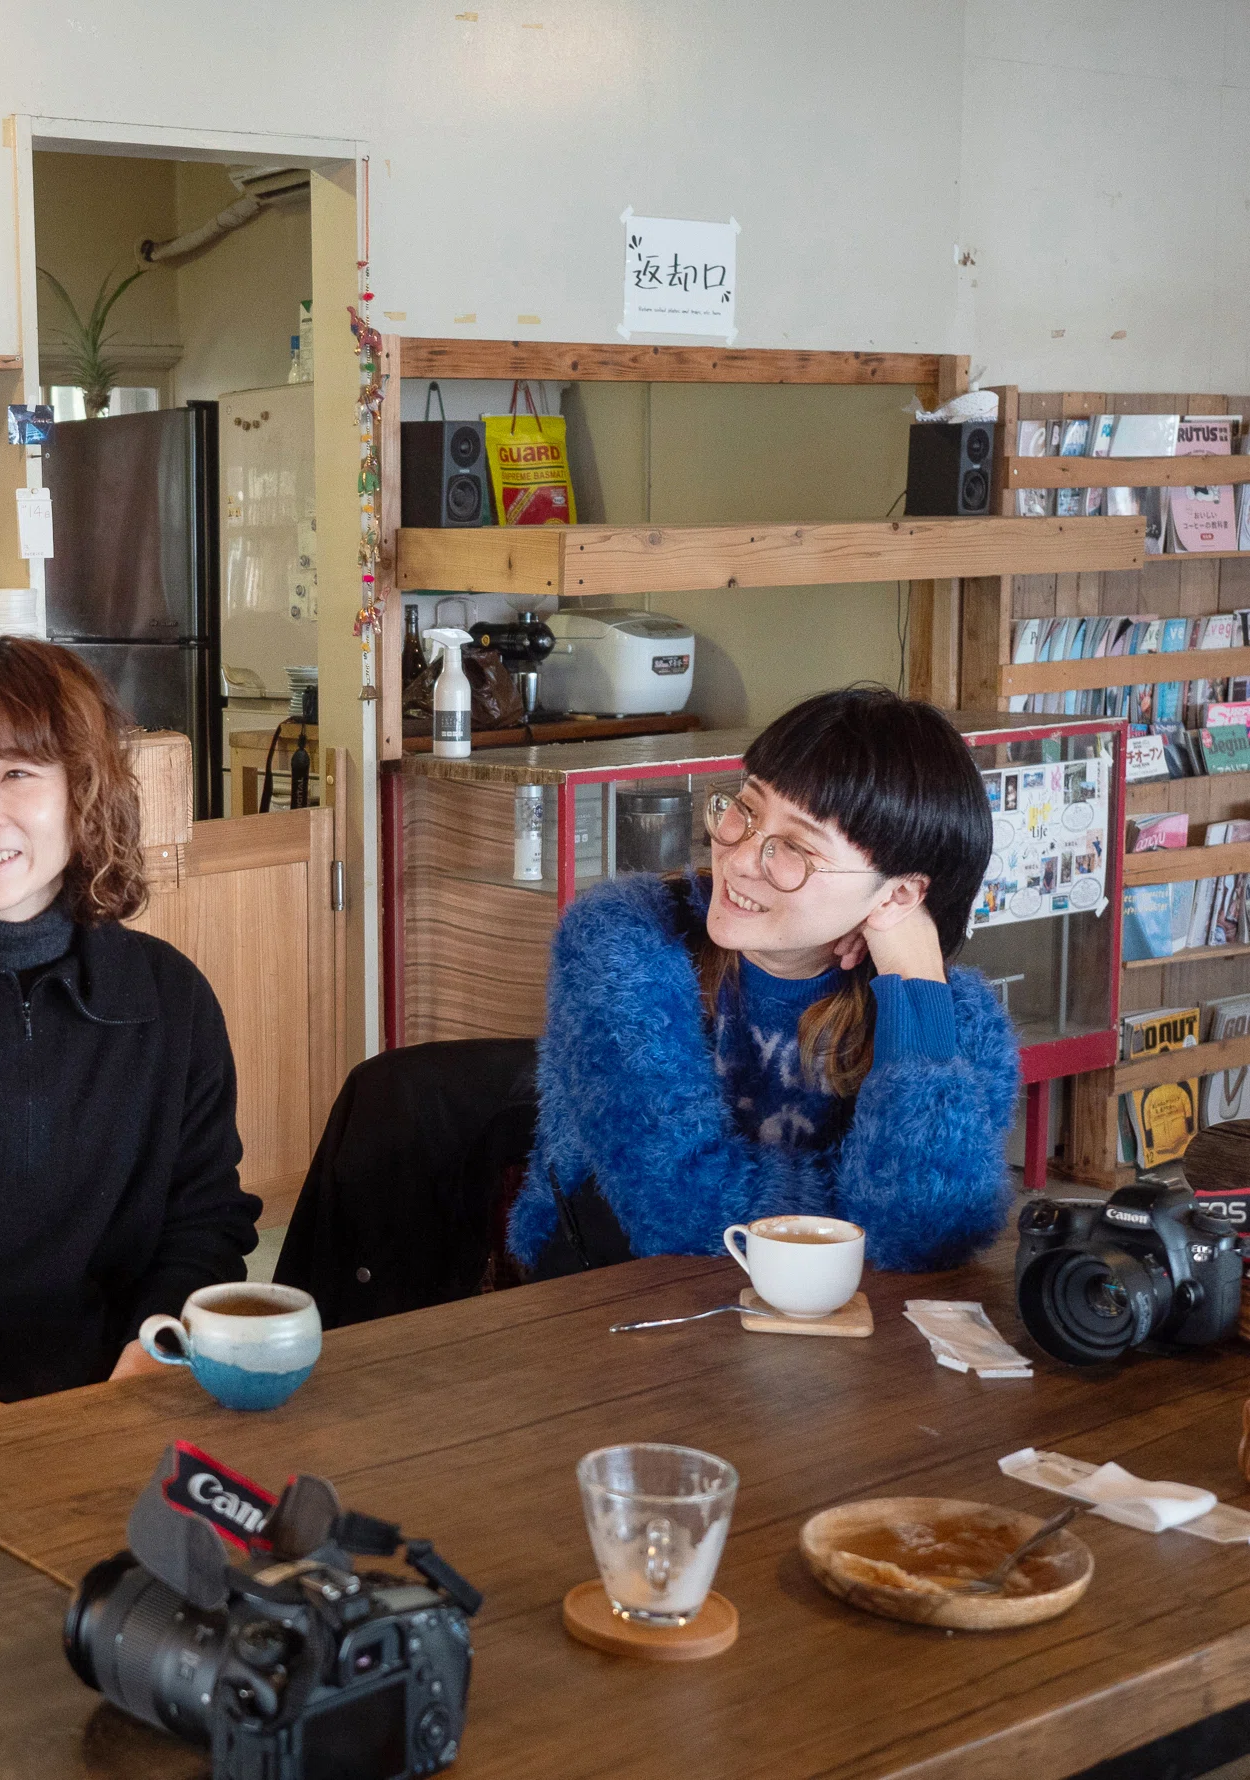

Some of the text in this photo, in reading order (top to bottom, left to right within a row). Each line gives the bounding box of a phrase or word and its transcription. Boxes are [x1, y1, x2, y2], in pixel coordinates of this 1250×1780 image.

[632, 253, 726, 292] 返却口
[1178, 426, 1218, 442] RUTUS
[1194, 511, 1218, 520] おいしい
[1106, 1208, 1149, 1224] Canon
[1199, 1201, 1247, 1223] OS
[1191, 1244, 1213, 1255] EOS
[187, 1472, 268, 1534] Can
